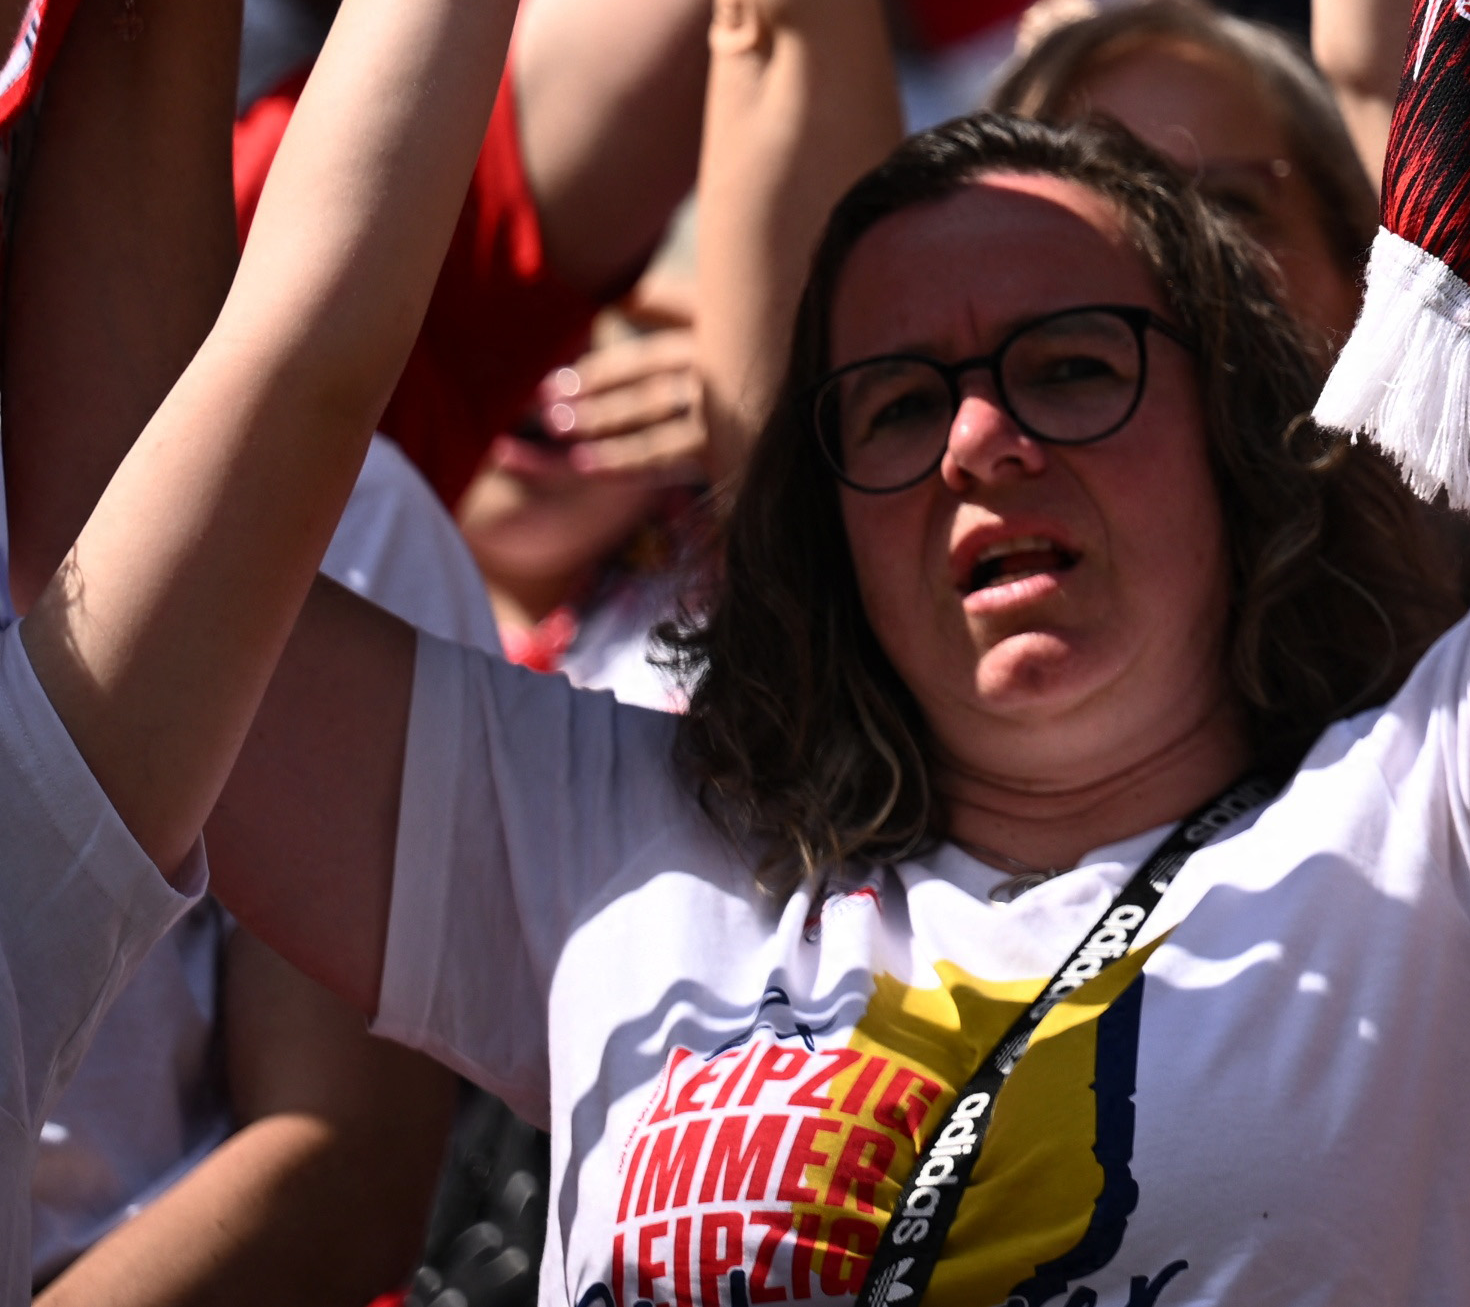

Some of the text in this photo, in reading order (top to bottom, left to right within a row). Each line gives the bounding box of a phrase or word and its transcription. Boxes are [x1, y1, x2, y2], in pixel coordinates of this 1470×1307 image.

[648, 1040, 943, 1154] LEIPZIG
[616, 1114, 897, 1225] IMMER
[892, 1091, 991, 1246] adidas
[611, 1210, 882, 1307] LEIPZIG
